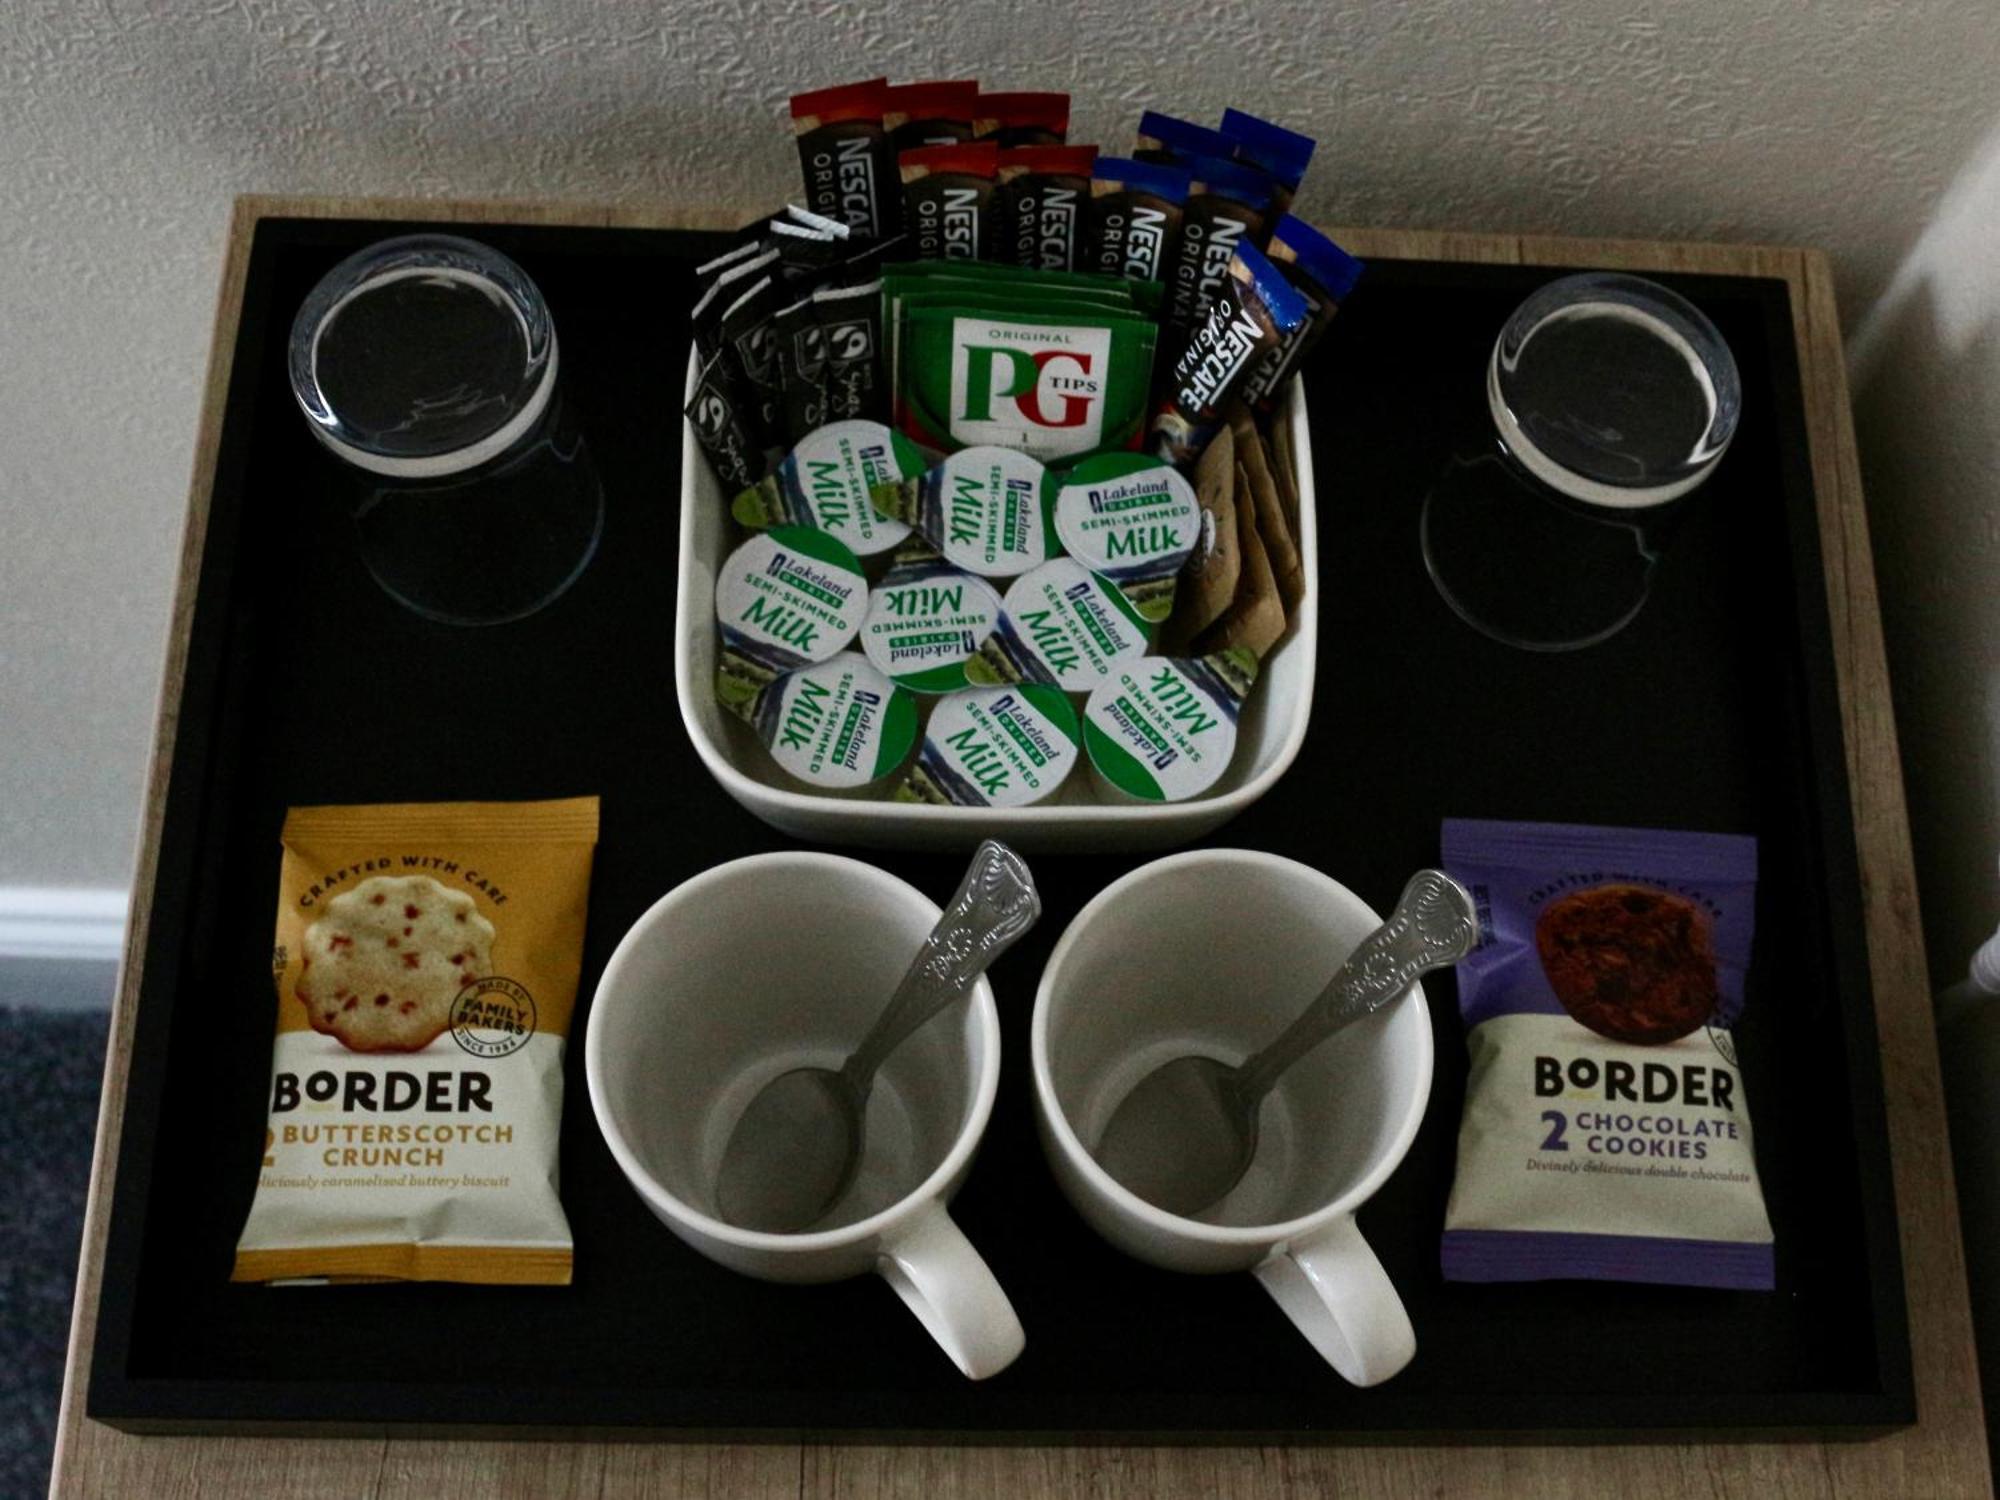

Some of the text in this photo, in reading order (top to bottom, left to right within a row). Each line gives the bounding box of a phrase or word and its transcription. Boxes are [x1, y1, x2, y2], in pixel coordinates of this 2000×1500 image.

[1039, 187, 1079, 272] NESCA
[988, 328, 1072, 344] ORIGINAL
[958, 343, 1096, 428] PG
[1050, 376, 1098, 392] TIPS
[807, 461, 850, 530] Milk
[839, 437, 873, 540] SEMI-SKIMMED
[949, 475, 985, 546] Milk
[985, 465, 1002, 564] SEMI-SKIMMED
[1103, 480, 1170, 501] Lakeland
[1016, 492, 1032, 554] Lakeland
[1080, 505, 1191, 532] SEMI-SKIMMED
[1107, 525, 1182, 560] Milk
[744, 573, 847, 631] SEMI-SKIMMED
[785, 559, 853, 599] Lakeland
[885, 585, 963, 616] Milk
[741, 596, 820, 652] Milk
[872, 615, 986, 633] SEMI-SKIMMED
[1020, 610, 1079, 676] Milk
[1043, 584, 1108, 674] SEMI-SKIMMED
[1084, 594, 1131, 650] Lakeland
[891, 643, 960, 662] Lakeland
[780, 677, 831, 750] Milk
[810, 672, 854, 774] SEMI-SKIMMED
[1121, 674, 1201, 763] SEMI-SKIMMED
[1151, 666, 1218, 735] Milk
[844, 705, 876, 771] Lakeland
[966, 702, 1040, 789] SEMI-SKIMMED
[1009, 705, 1061, 760] Lakeland
[1103, 703, 1160, 759] Lakeland
[946, 727, 1010, 796] Milk
[300, 855, 509, 907] CRAFTED WITH CARE
[457, 1011, 526, 1036] BAKERS
[463, 998, 528, 1023] FAMILY
[272, 1070, 493, 1113] BORDER
[1535, 1056, 1734, 1112] BORDER
[283, 1124, 513, 1144] BUTTERSCOTCH
[323, 1148, 444, 1167] CRUNCH
[1540, 1110, 1739, 1151] 2 CHOCOLATE
[1588, 1135, 1707, 1160] COOKIES
[259, 1174, 318, 1190] liciously
[410, 1174, 460, 1190] buttery
[462, 1174, 510, 1187] biscuit
[1526, 1158, 1751, 1183] Divinely delicious double chocolate
